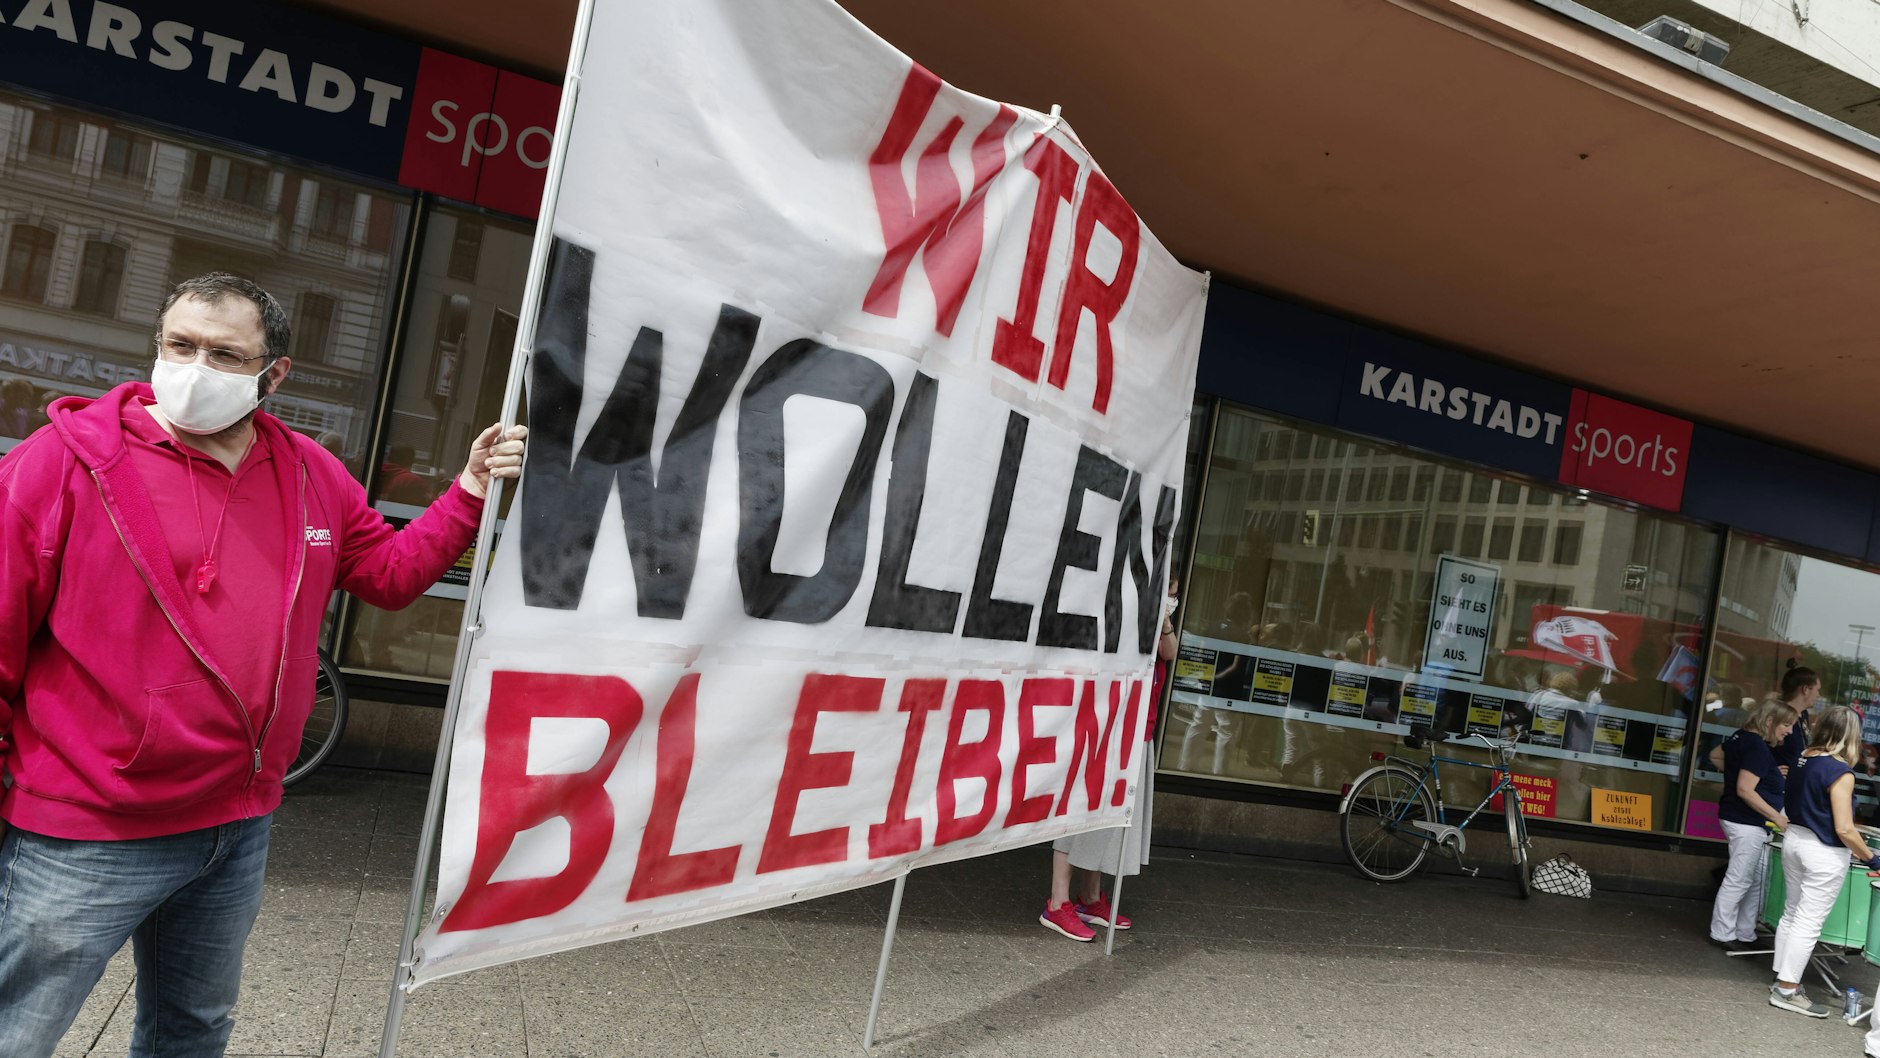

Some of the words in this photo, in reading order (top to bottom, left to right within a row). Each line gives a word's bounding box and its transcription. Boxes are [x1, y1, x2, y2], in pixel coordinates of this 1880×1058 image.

[0, 0, 403, 128] ARSTADT
[861, 60, 1141, 416] WIR
[1359, 362, 1562, 445] KARSTADT
[1571, 422, 1678, 477] sports
[520, 235, 1177, 655] WOLLEN
[1460, 573, 1475, 585] SO
[1440, 595, 1472, 611] SIEHT
[1473, 602, 1487, 614] ES
[1433, 620, 1462, 635] OHNE
[1465, 624, 1486, 638] UNS
[1443, 648, 1467, 662] AUS.
[1848, 674, 1875, 689] WENN
[1851, 689, 1880, 702] STAND
[439, 670, 1142, 934] BLEIBEN!
[1517, 788, 1535, 800] ollen
[1536, 790, 1551, 802] hier
[1606, 793, 1639, 806] ZUKUNFT
[1527, 802, 1546, 815] WEG!
